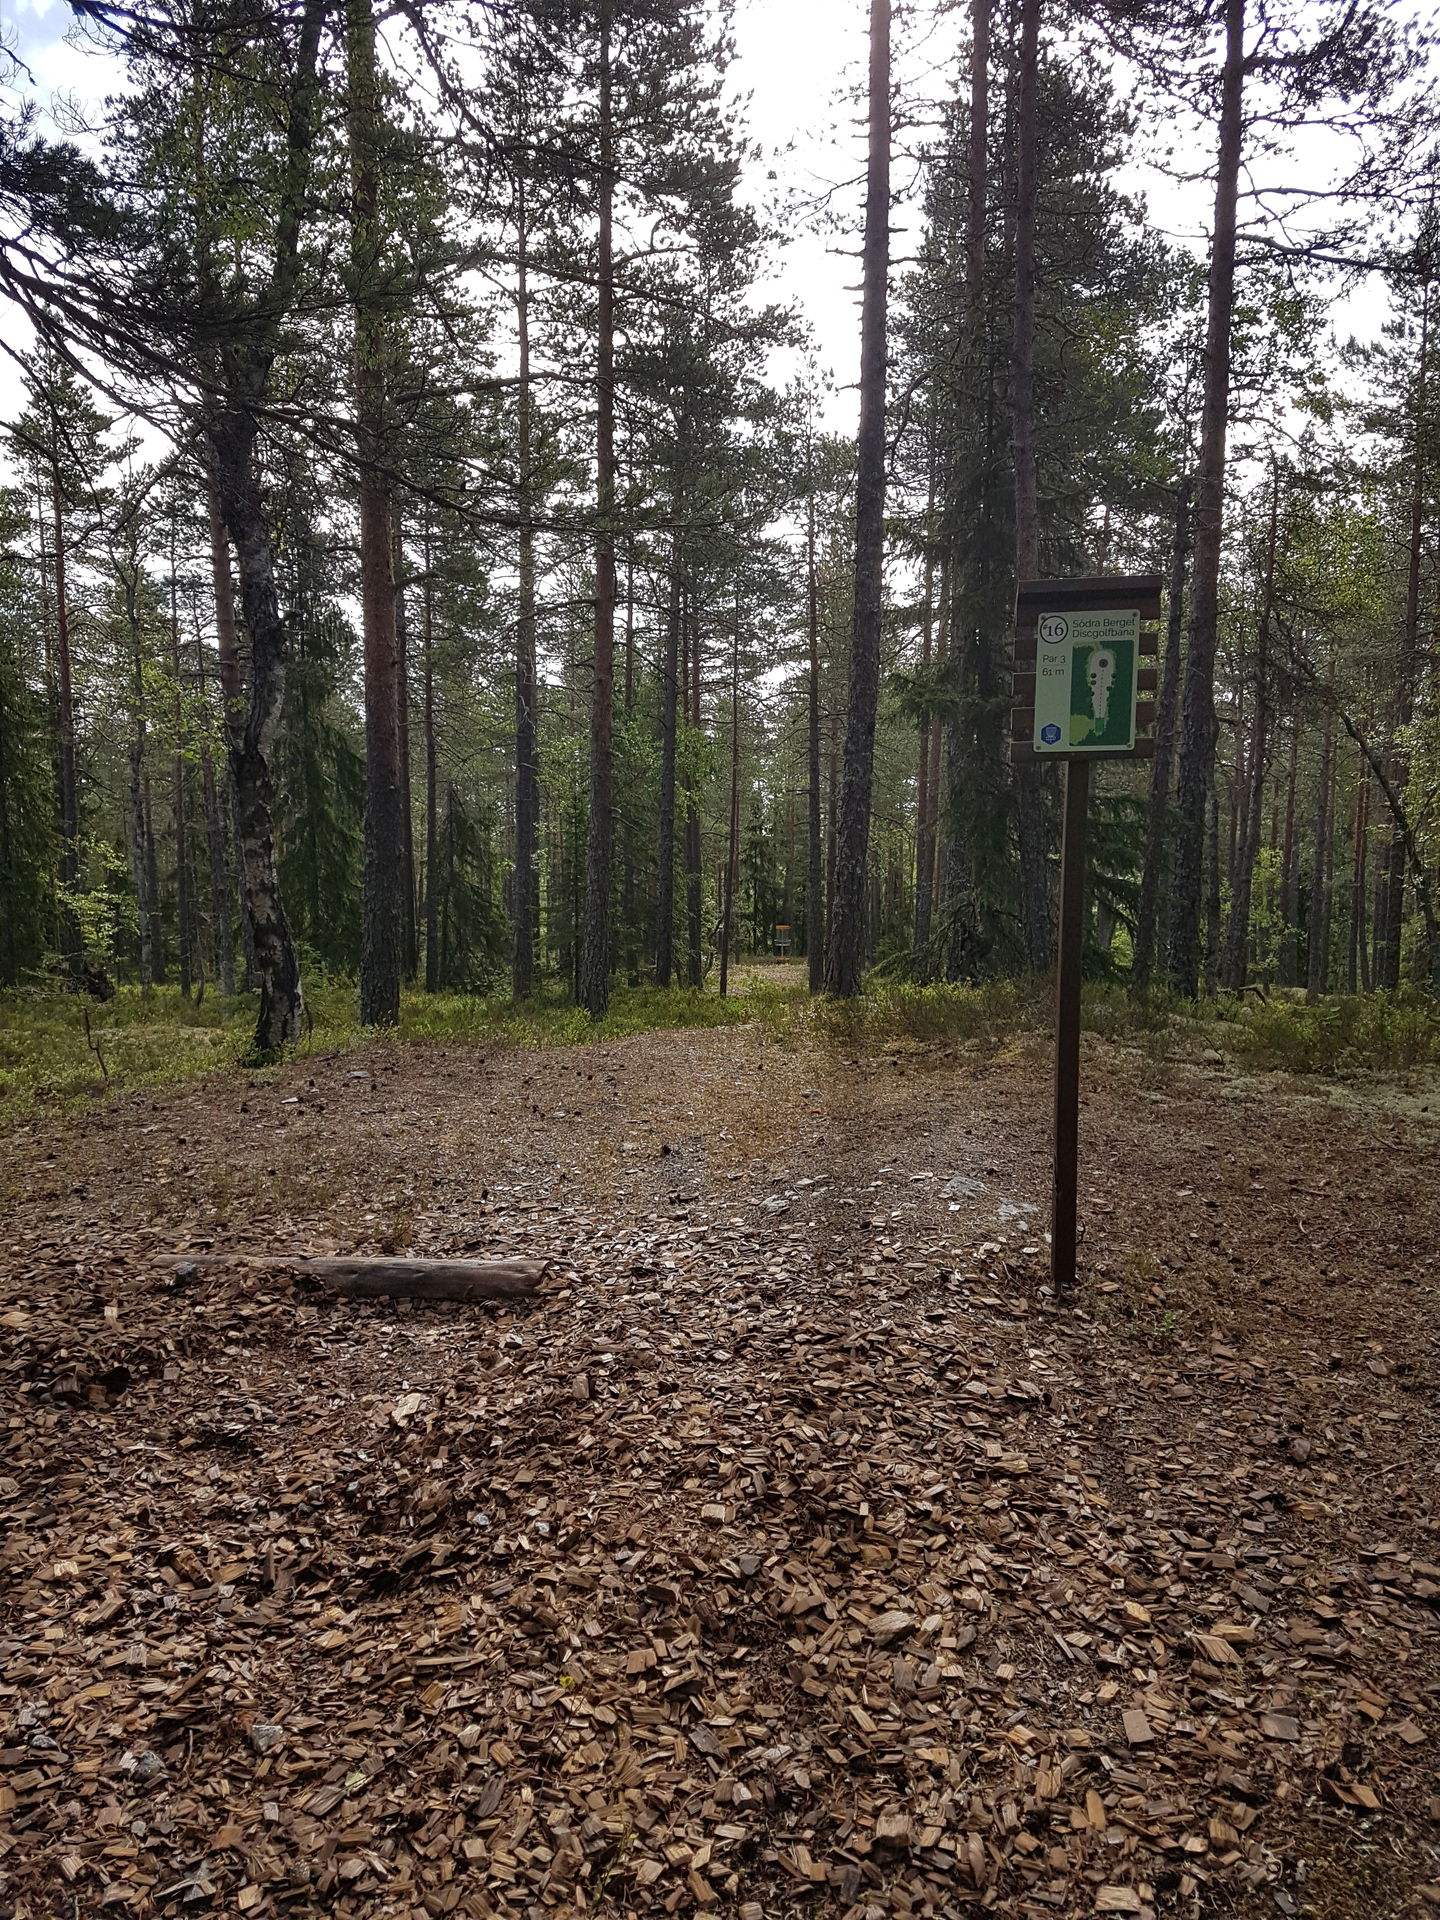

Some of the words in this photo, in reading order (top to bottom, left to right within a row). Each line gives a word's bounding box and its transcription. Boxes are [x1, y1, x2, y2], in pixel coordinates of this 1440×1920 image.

[1072, 619, 1101, 628] Södra
[1103, 618, 1136, 628] Berget
[1072, 628, 1135, 639] Discgolfbana
[1042, 654, 1058, 663] Par
[1060, 655, 1066, 664] 3
[1042, 667, 1053, 676] 61
[1055, 668, 1065, 676] m
